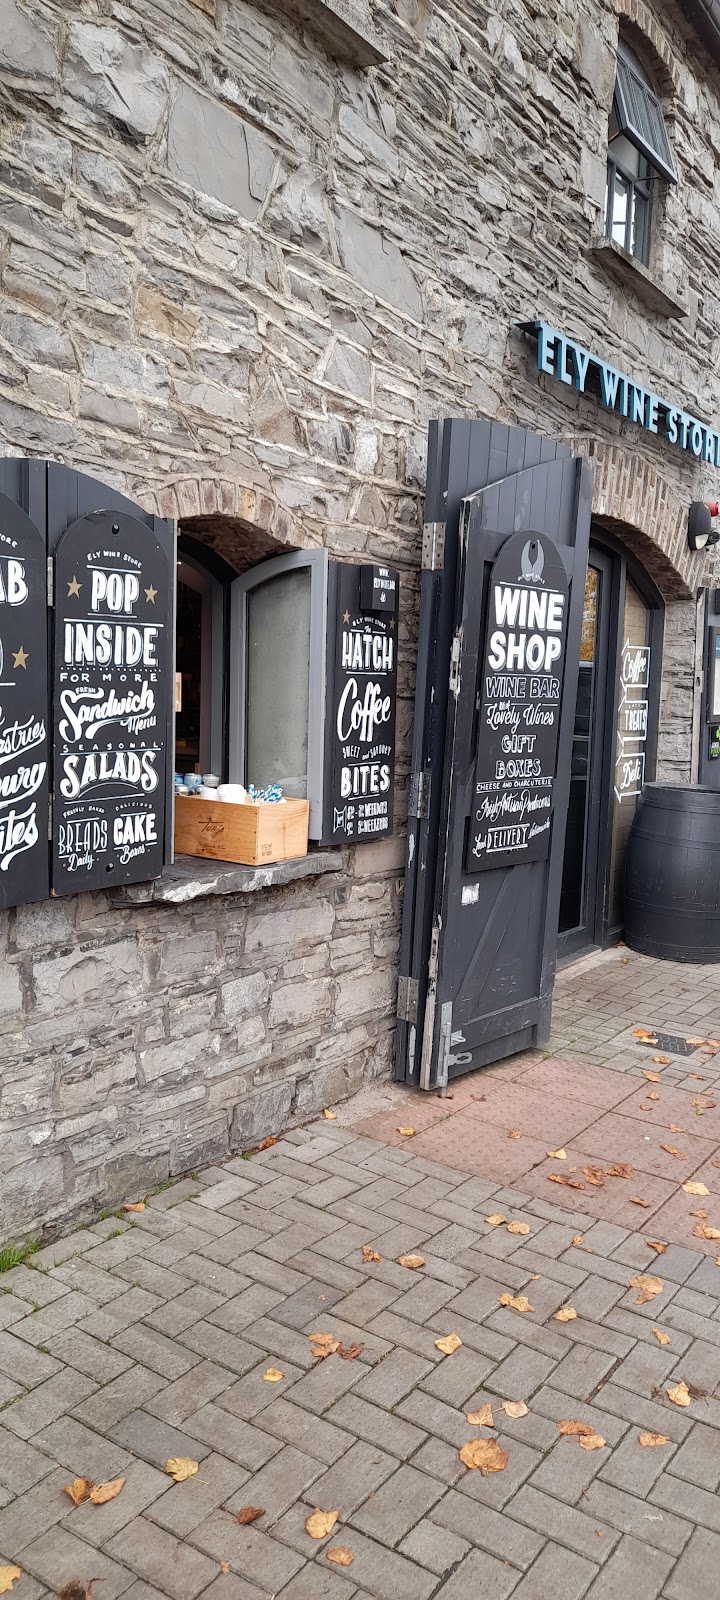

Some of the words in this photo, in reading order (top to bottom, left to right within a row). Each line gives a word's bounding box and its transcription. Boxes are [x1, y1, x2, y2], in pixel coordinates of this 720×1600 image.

[537, 321, 591, 393] ELY
[600, 358, 661, 434] WINE
[86, 550, 101, 562] ELY
[103, 550, 121, 558] WINE
[122, 553, 143, 569] STORE
[91, 570, 140, 614] POP
[494, 585, 565, 632] WINE
[64, 622, 159, 668] INSIDE
[341, 630, 393, 671] HATCH
[487, 630, 562, 672] SHOP
[59, 672, 90, 683] FOR
[102, 672, 158, 683] MORE
[622, 649, 647, 684] Coffee
[75, 686, 96, 695] FRESH
[485, 676, 527, 698] WINE
[529, 677, 560, 699] BAR
[58, 680, 155, 743] Sandwich
[120, 715, 157, 736] Menu
[336, 677, 391, 742] Coffee
[486, 702, 521, 734] Lovely
[522, 702, 554, 726] Wines
[624, 709, 647, 731] TREATS
[62, 741, 159, 753] SEASONAL
[342, 744, 361, 759] SWEET
[501, 734, 537, 753] GIFT
[0, 762, 47, 805] ury
[59, 750, 160, 800] SALADS
[340, 764, 391, 798] BITES
[476, 782, 500, 791] CHEESE
[502, 781, 513, 789] AND
[513, 778, 552, 788] CHARCUTERIE
[495, 758, 542, 780] BOXES
[619, 758, 641, 790] Deli
[114, 801, 153, 812] DELICIOUS
[0, 802, 39, 870] ites
[58, 819, 108, 855] BREADS
[113, 812, 158, 846] CAKE
[486, 827, 528, 849] DELIVERY
[67, 850, 95, 872] Daily
